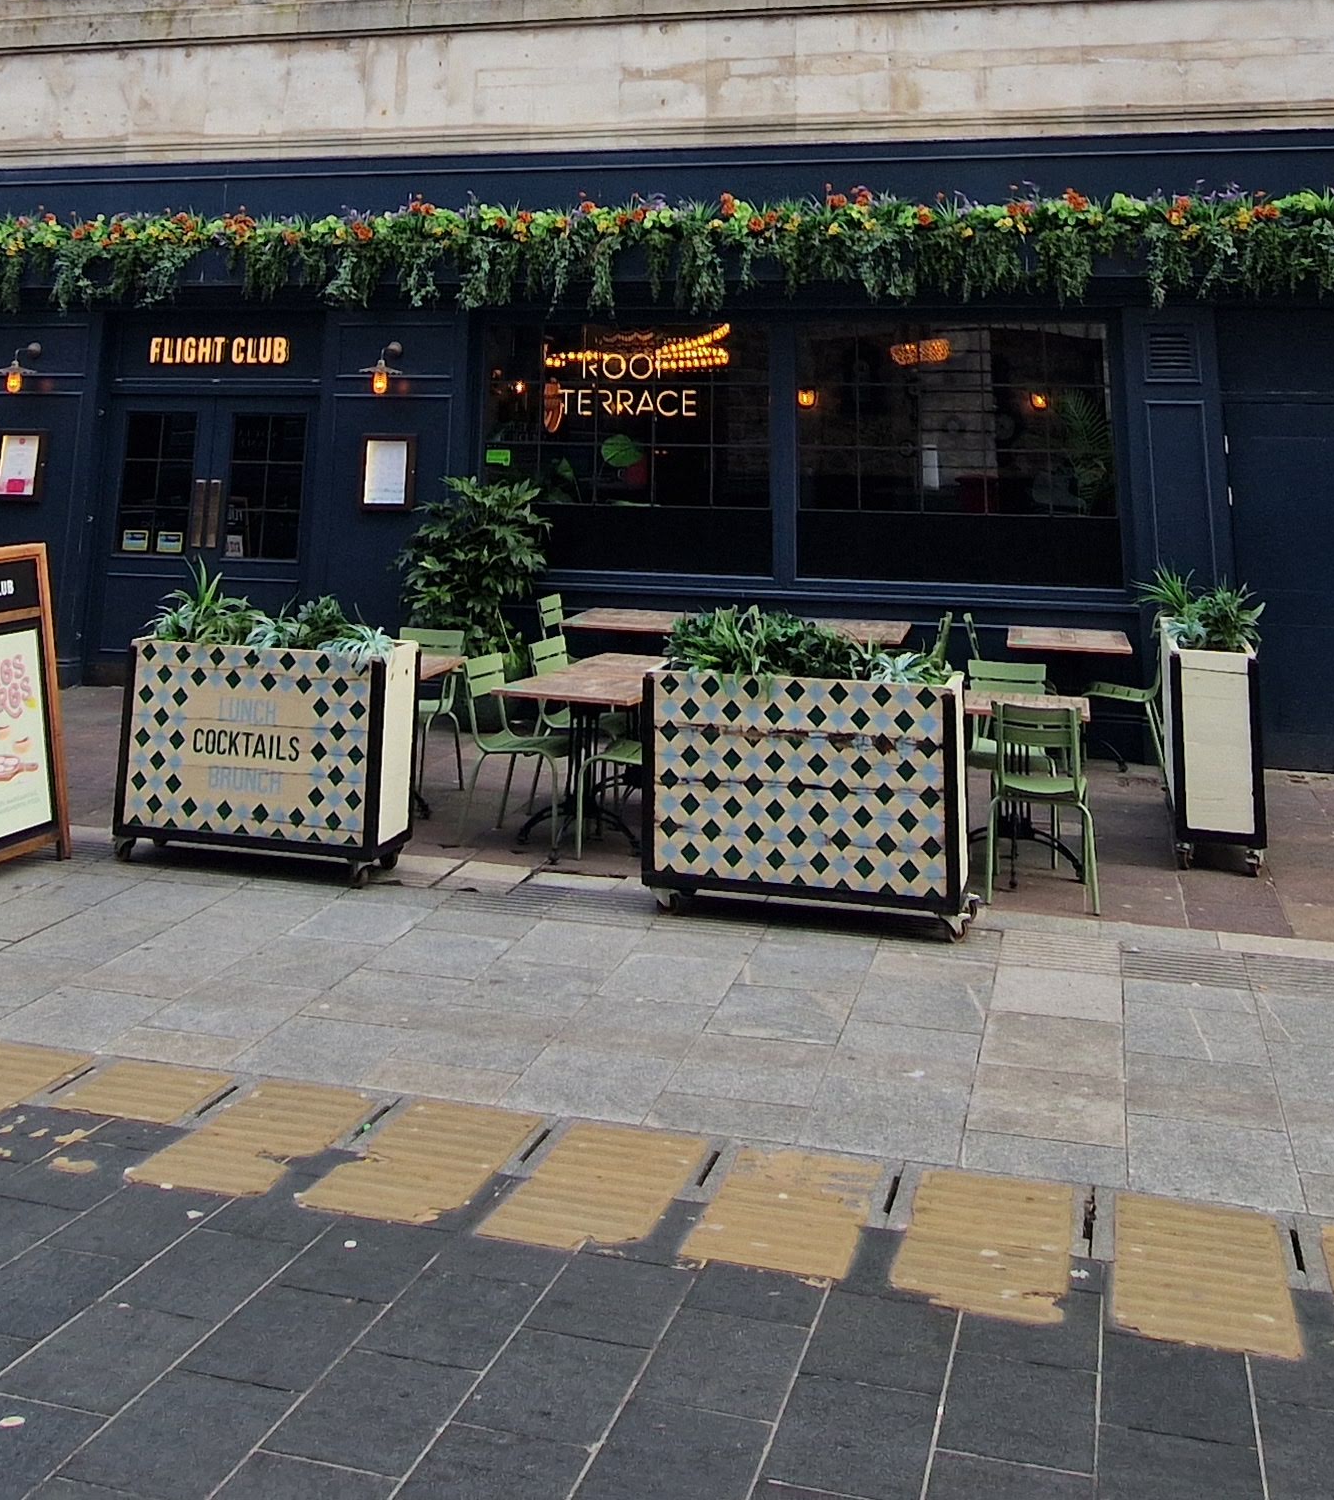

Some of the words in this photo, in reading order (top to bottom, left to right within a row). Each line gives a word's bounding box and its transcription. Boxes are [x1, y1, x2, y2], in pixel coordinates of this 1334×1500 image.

[149, 336, 226, 364] FLIGHT
[231, 336, 290, 364] CLUB
[558, 389, 697, 417] TERRACE
[219, 697, 277, 725] LUNCH
[192, 728, 300, 762] COCKTAILS
[208, 766, 282, 794] BRUNCH
